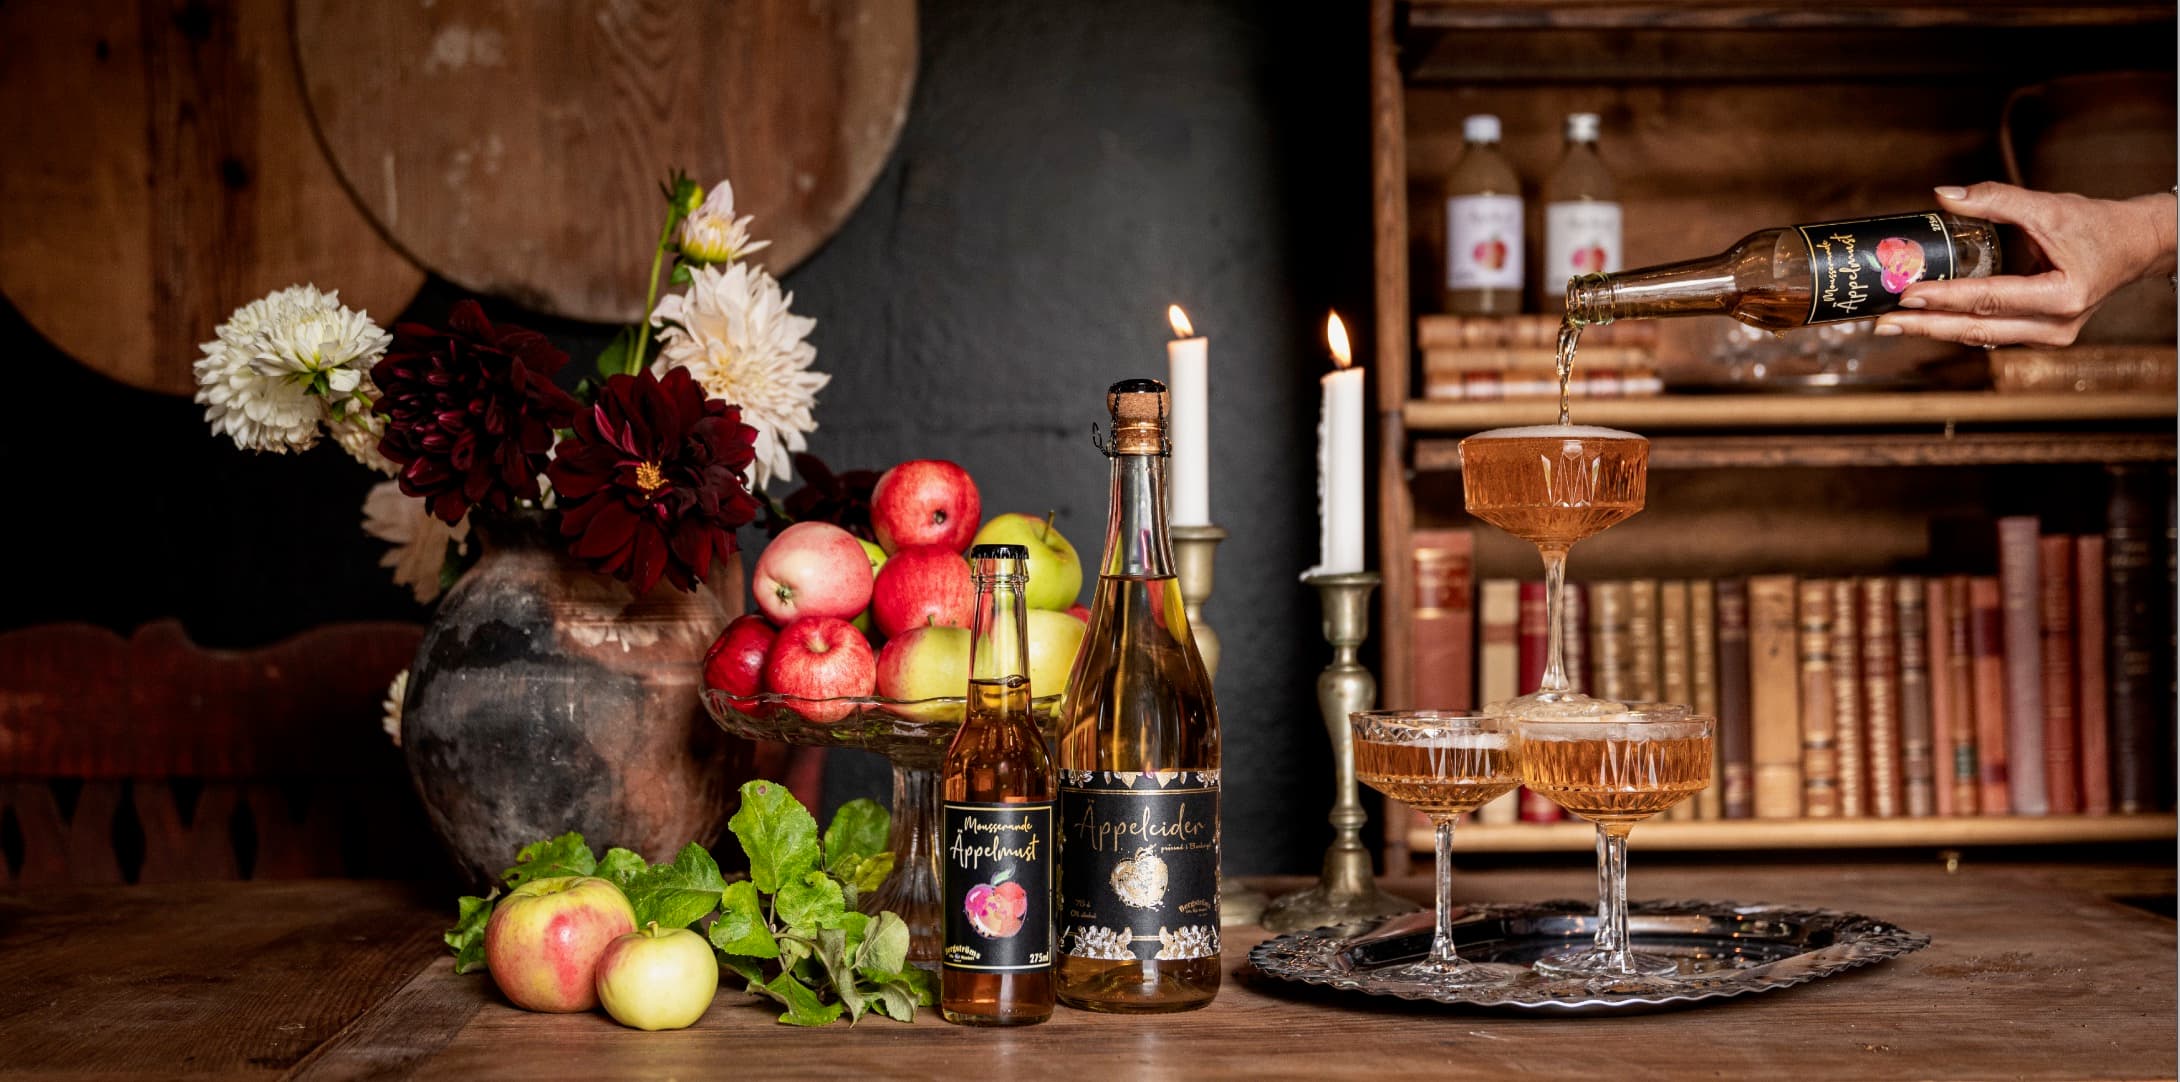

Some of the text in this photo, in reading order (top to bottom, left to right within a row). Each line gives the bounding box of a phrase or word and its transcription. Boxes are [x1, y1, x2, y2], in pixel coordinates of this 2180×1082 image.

[1816, 239, 1839, 303] Mousserande
[1830, 233, 1869, 314] Äppelmust
[949, 828, 1040, 870] Äppelmust
[964, 815, 1033, 835] Mousserande
[1074, 798, 1206, 852] Äppelcider
[1029, 951, 1049, 963] 275ml
